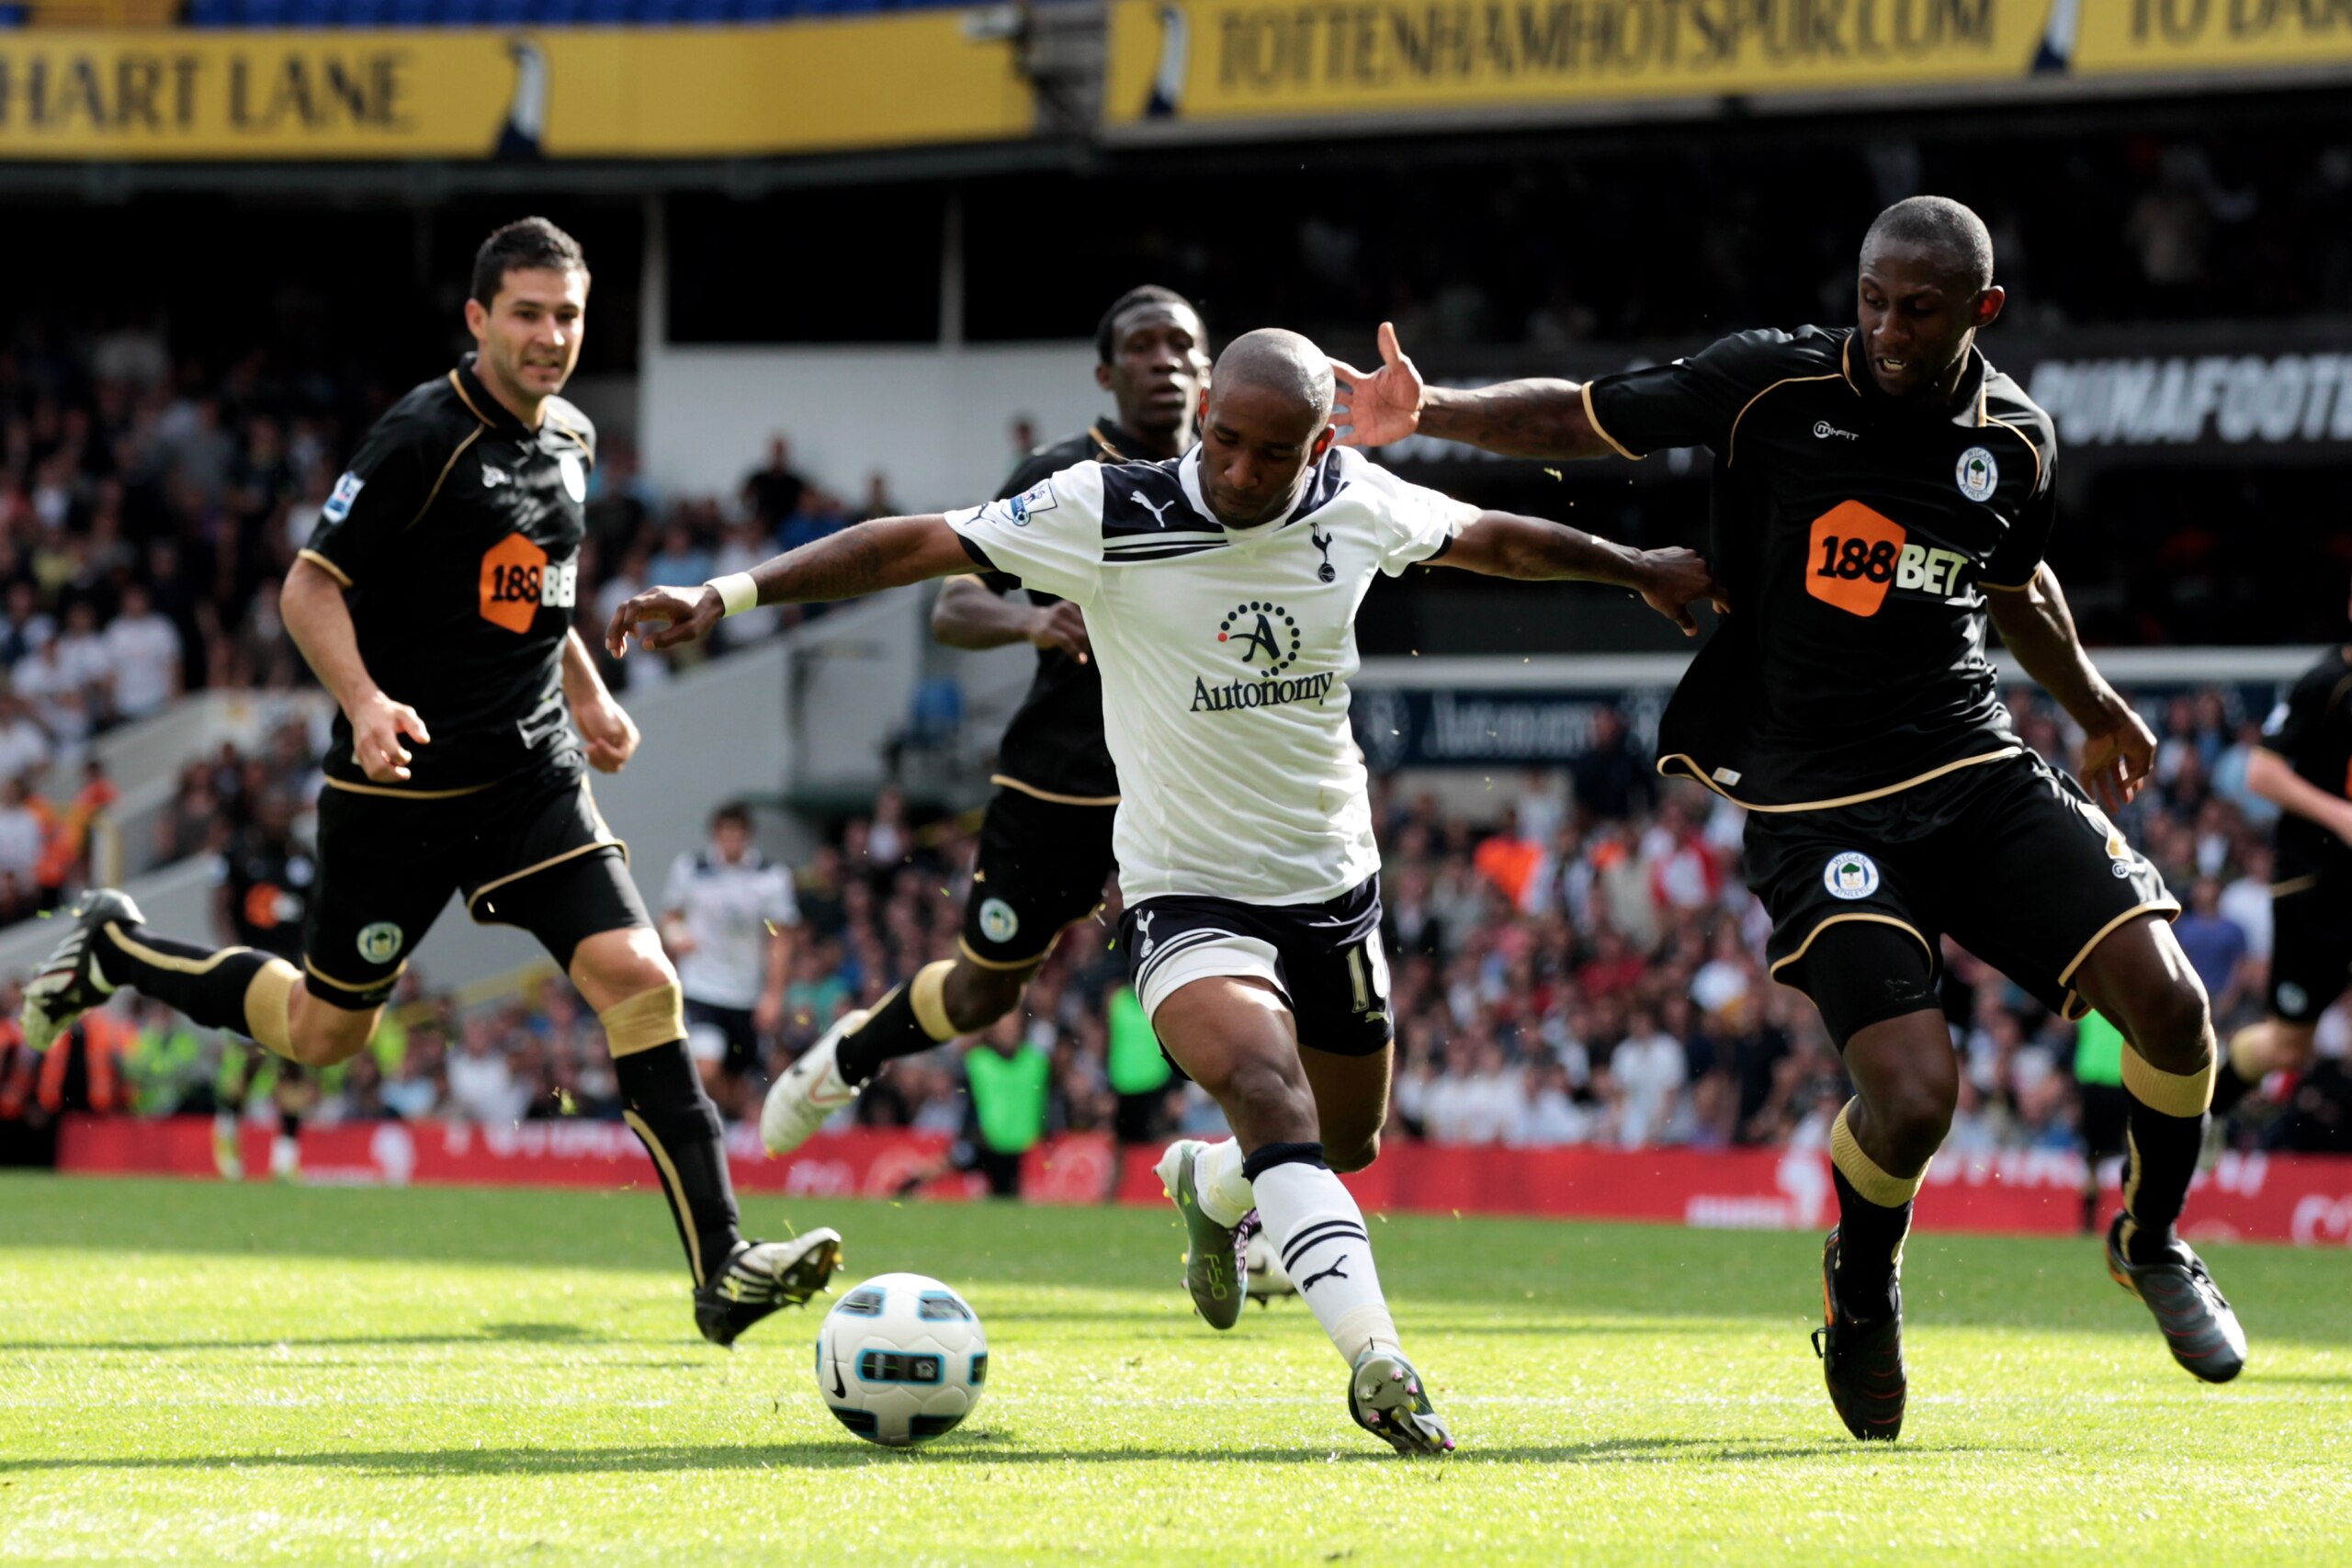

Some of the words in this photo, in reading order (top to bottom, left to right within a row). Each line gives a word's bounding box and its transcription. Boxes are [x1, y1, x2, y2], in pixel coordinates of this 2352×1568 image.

[230, 52, 416, 131] LANE
[1816, 536, 1969, 596] 188BET
[1190, 671, 1333, 712] Autonomy
